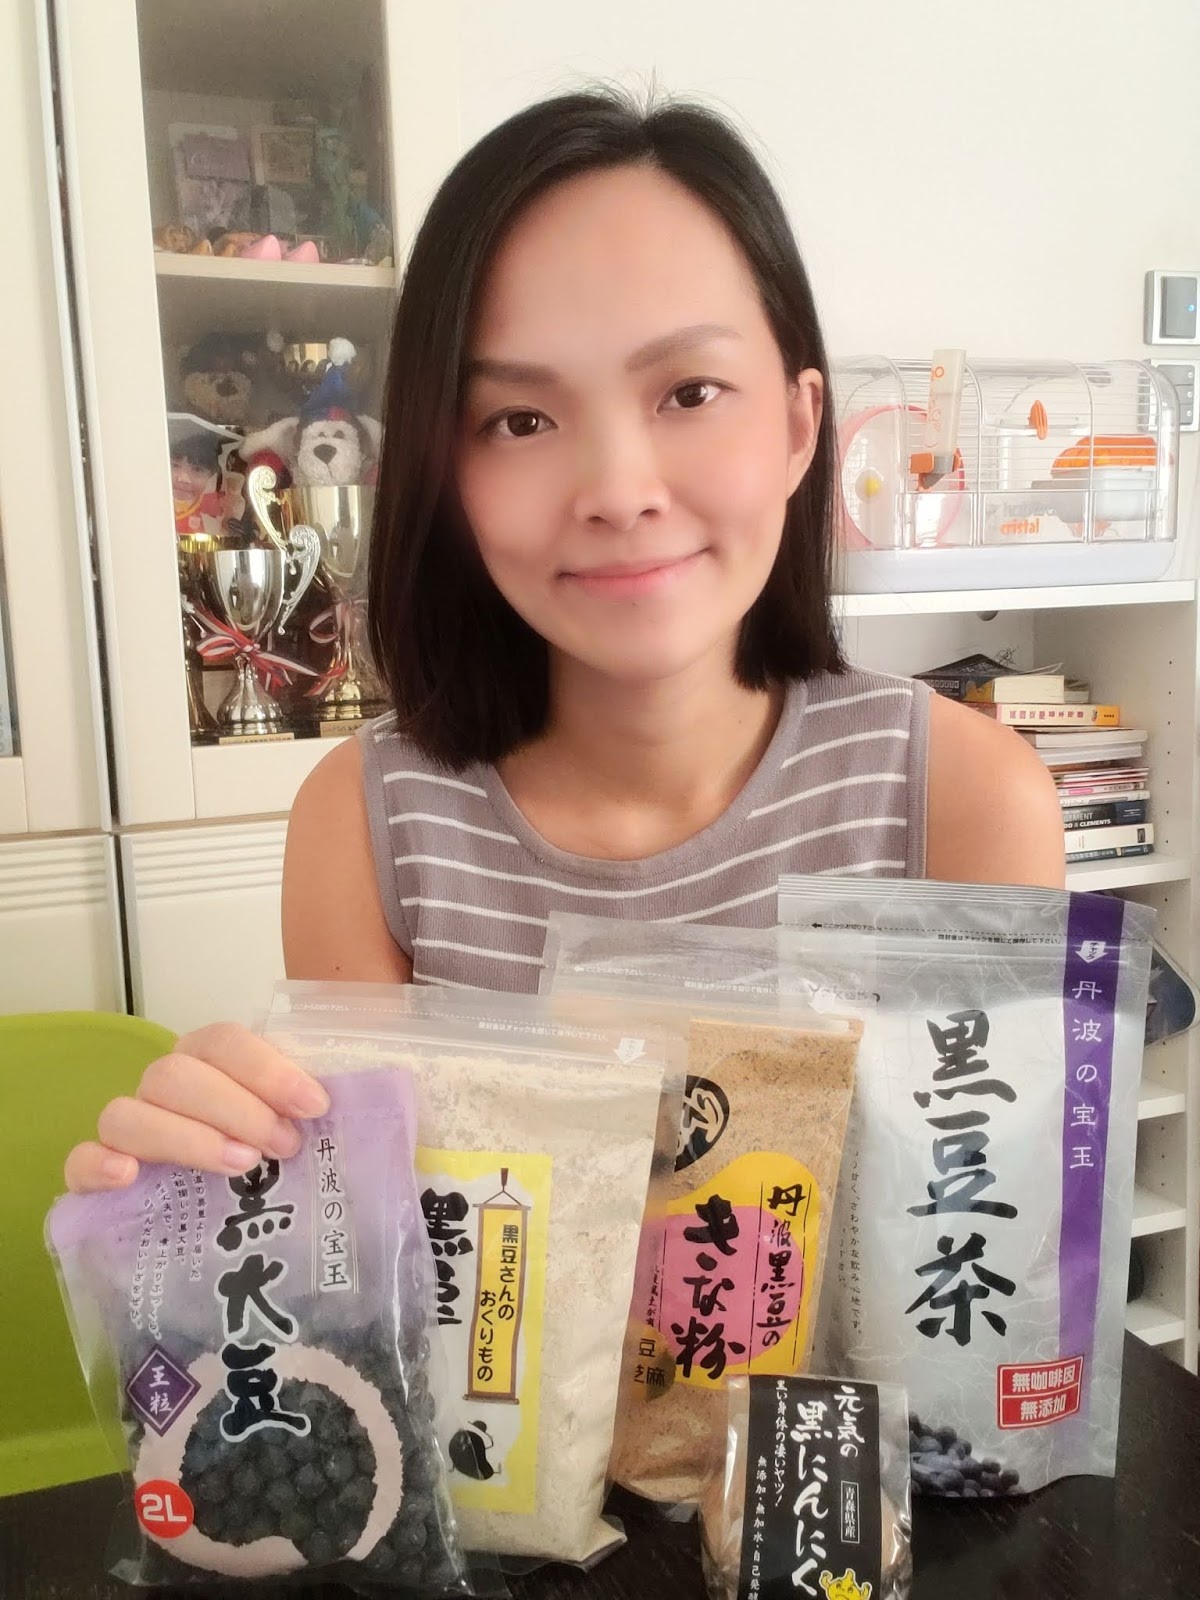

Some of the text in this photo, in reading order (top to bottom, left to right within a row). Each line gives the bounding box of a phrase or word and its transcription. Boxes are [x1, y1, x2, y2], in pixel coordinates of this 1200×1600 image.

[1001, 518, 1040, 535] cristal
[1080, 818, 1111, 827] CLEMENTS
[1070, 979, 1103, 1170] 丹波の宝玉
[316, 1137, 350, 1288] 丹波の宝玉
[905, 1009, 1018, 1347] 黒豆茶
[216, 1158, 310, 1440] 黒大豆
[498, 1223, 519, 1321] 黒豆さんの
[670, 1193, 747, 1381] きな粉
[756, 1183, 808, 1347] 丹波黒豆の
[476, 1289, 498, 1383] おくりもの
[1011, 1364, 1076, 1394] 無咖啡因
[833, 1384, 865, 1458] 元気の
[1020, 1393, 1067, 1421] 無添加
[140, 1490, 188, 1525] 2L
[789, 1399, 833, 1597] 黒にんにく
[844, 1486, 857, 1538] 青森県産
